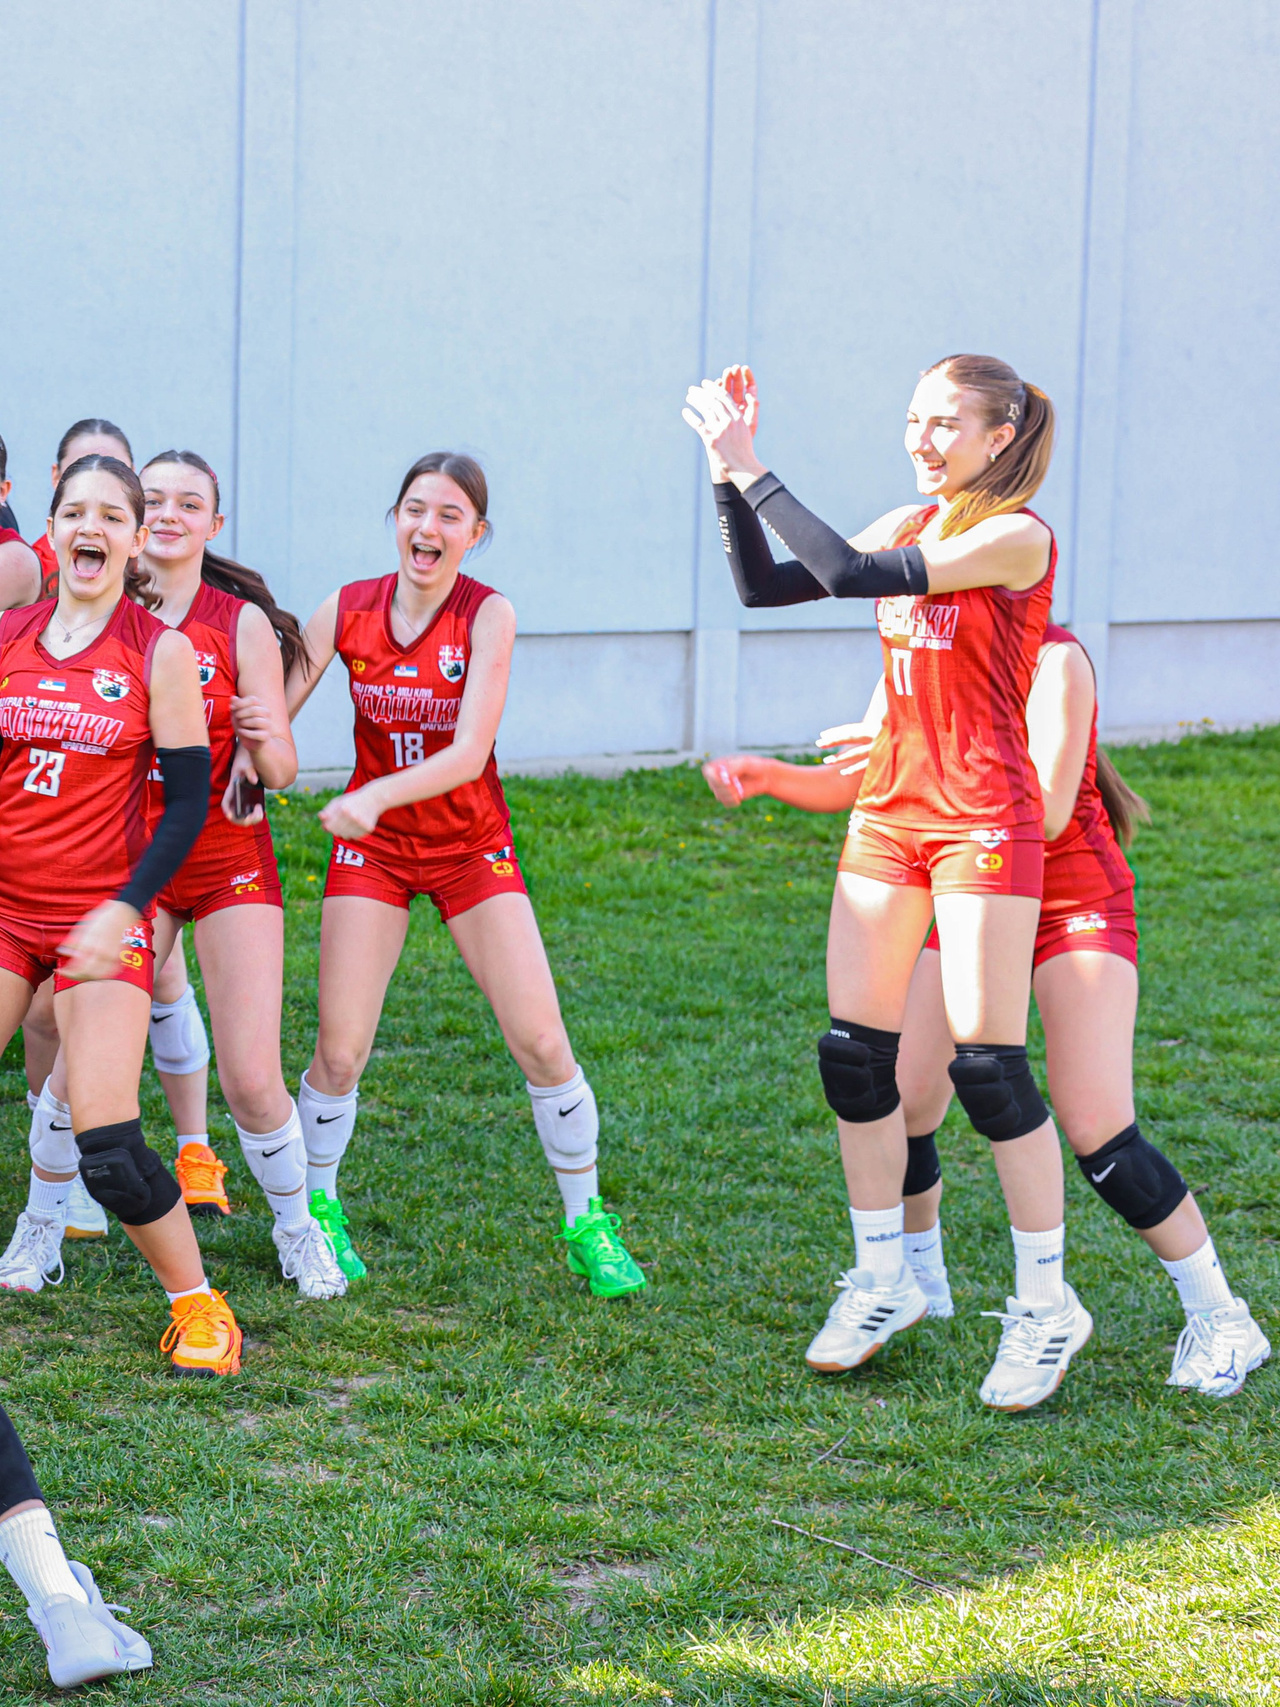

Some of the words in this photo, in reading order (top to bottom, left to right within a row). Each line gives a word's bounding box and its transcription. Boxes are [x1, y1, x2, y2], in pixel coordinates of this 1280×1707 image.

[891, 648, 913, 696] 11
[23, 747, 66, 797] 23
[389, 732, 424, 768] 18
